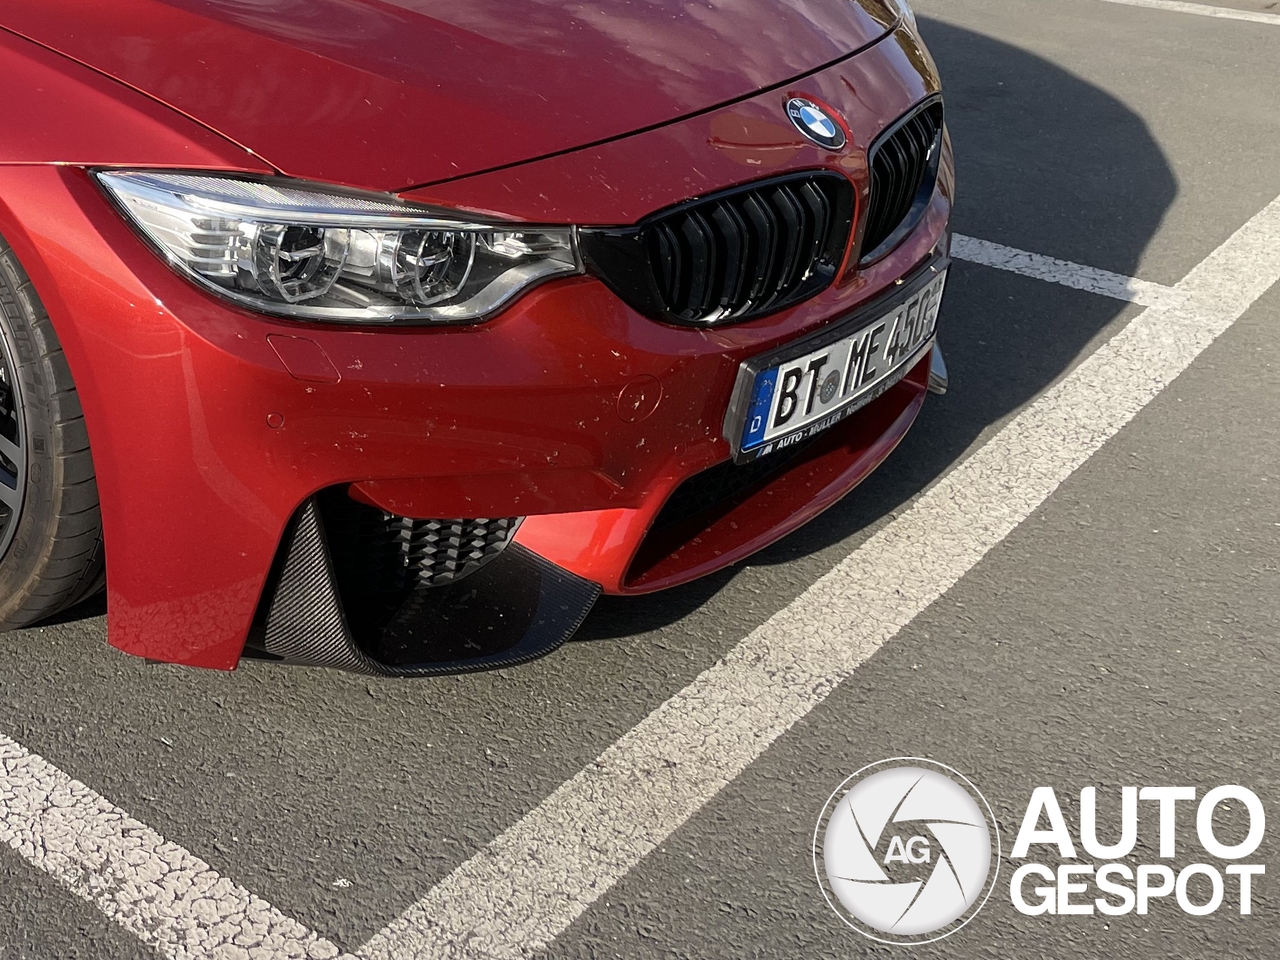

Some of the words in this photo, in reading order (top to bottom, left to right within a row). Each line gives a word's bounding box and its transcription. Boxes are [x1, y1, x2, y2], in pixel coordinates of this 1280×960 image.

[771, 353, 829, 430] BT
[839, 322, 886, 398] ME
[750, 415, 762, 434] D
[776, 431, 803, 450] AUTO
